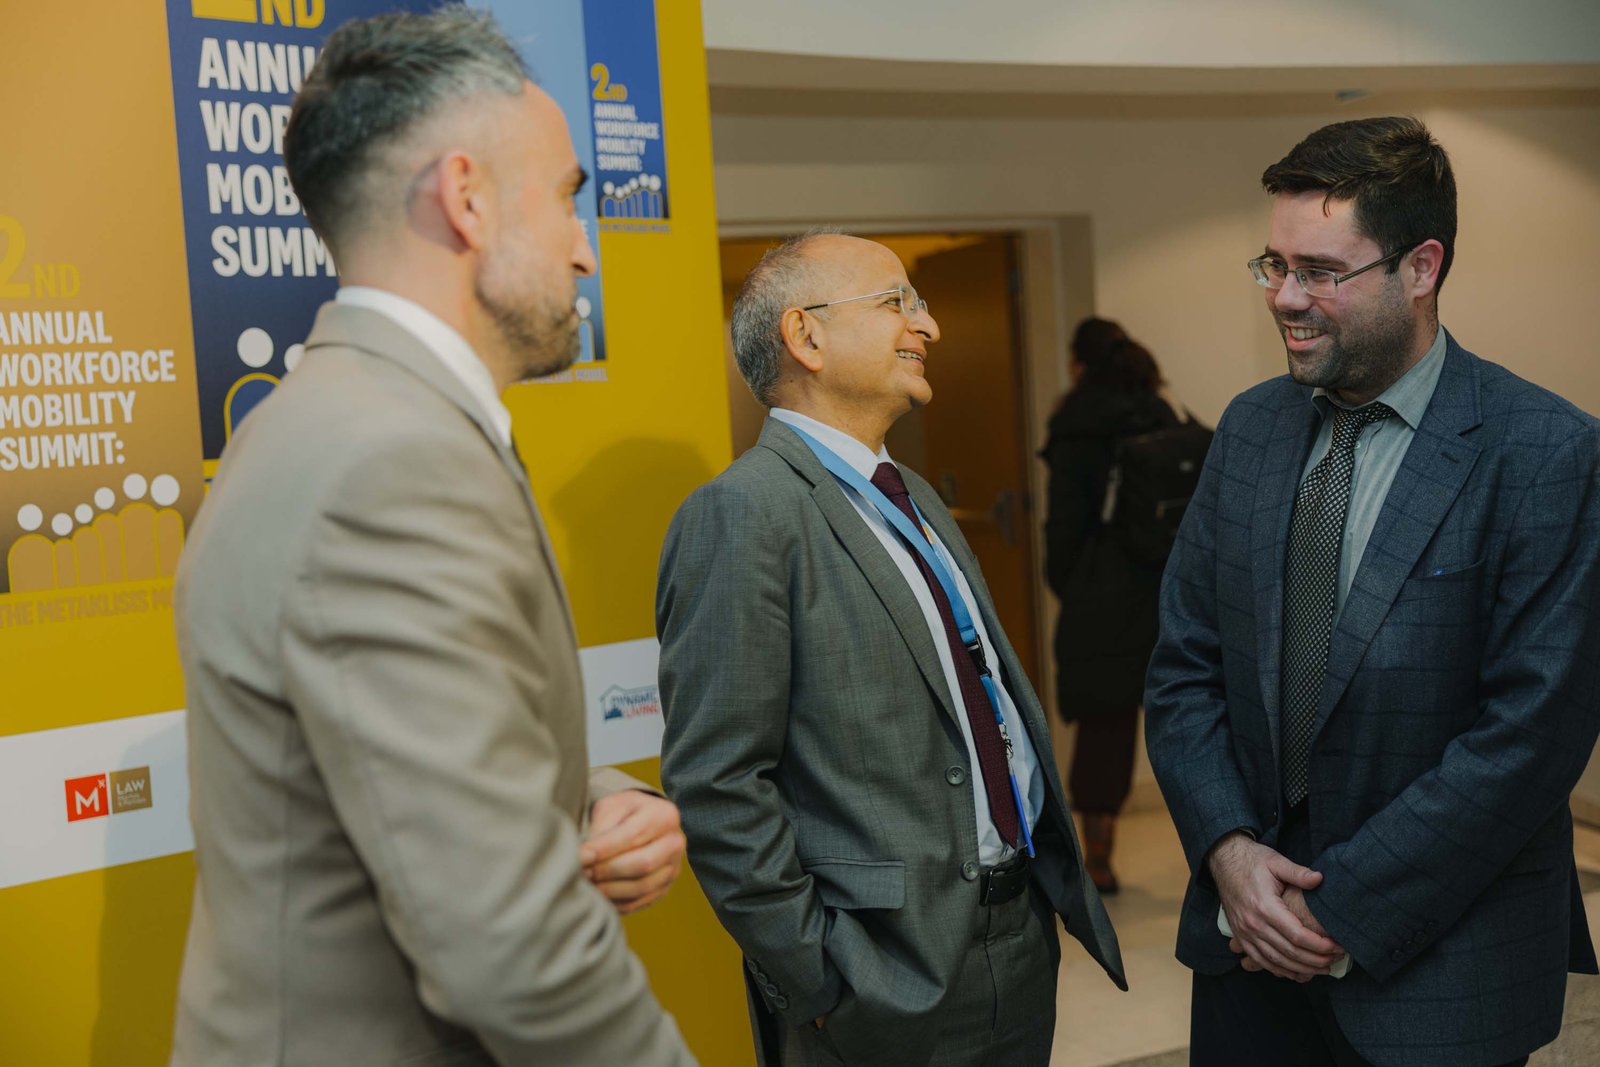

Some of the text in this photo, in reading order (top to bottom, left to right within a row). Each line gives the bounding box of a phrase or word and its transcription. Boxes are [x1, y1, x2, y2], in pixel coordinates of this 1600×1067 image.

[594, 103, 638, 120] ANNUAL
[594, 121, 660, 139] WORKFORCE
[596, 138, 646, 155] MOBILITY
[206, 162, 307, 216] MOB
[211, 224, 341, 278] SUMM
[0, 310, 113, 346] ANNUAL
[0, 349, 176, 388] WORKFORCE
[0, 390, 136, 430] MOBILITY
[0, 431, 125, 472] SUMMIT:
[116, 779, 145, 796] LAW
